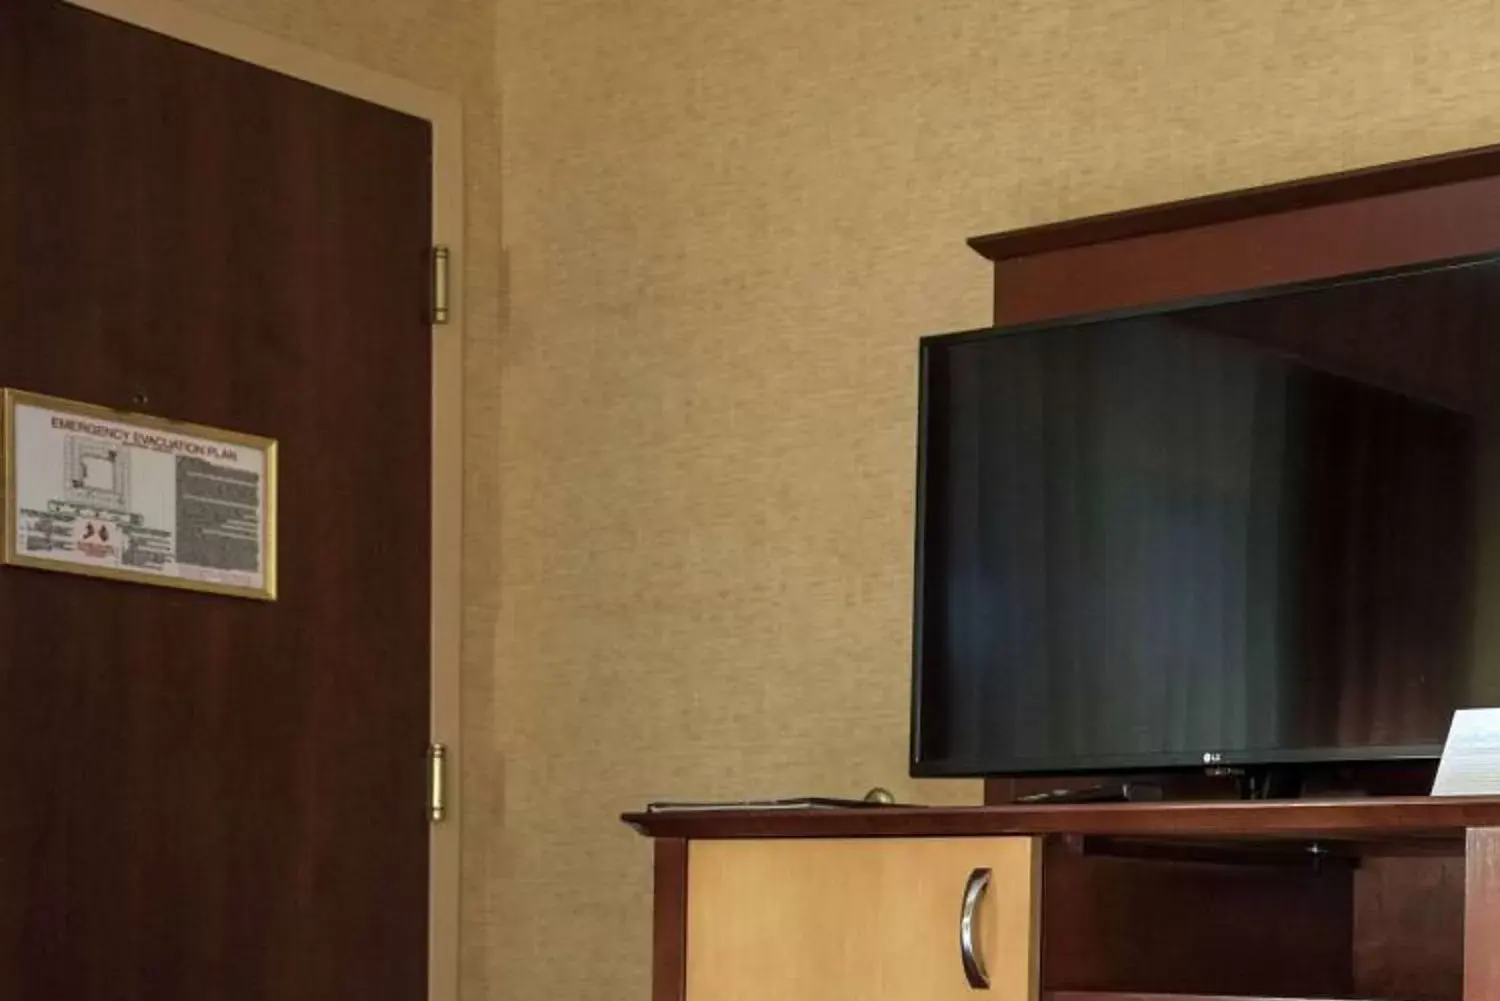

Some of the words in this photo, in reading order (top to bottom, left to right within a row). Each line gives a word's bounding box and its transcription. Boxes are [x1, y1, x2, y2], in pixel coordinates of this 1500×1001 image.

[51, 416, 130, 440] EMERGENCY
[133, 431, 204, 455] EVACUATION
[206, 447, 238, 462] PLAN
